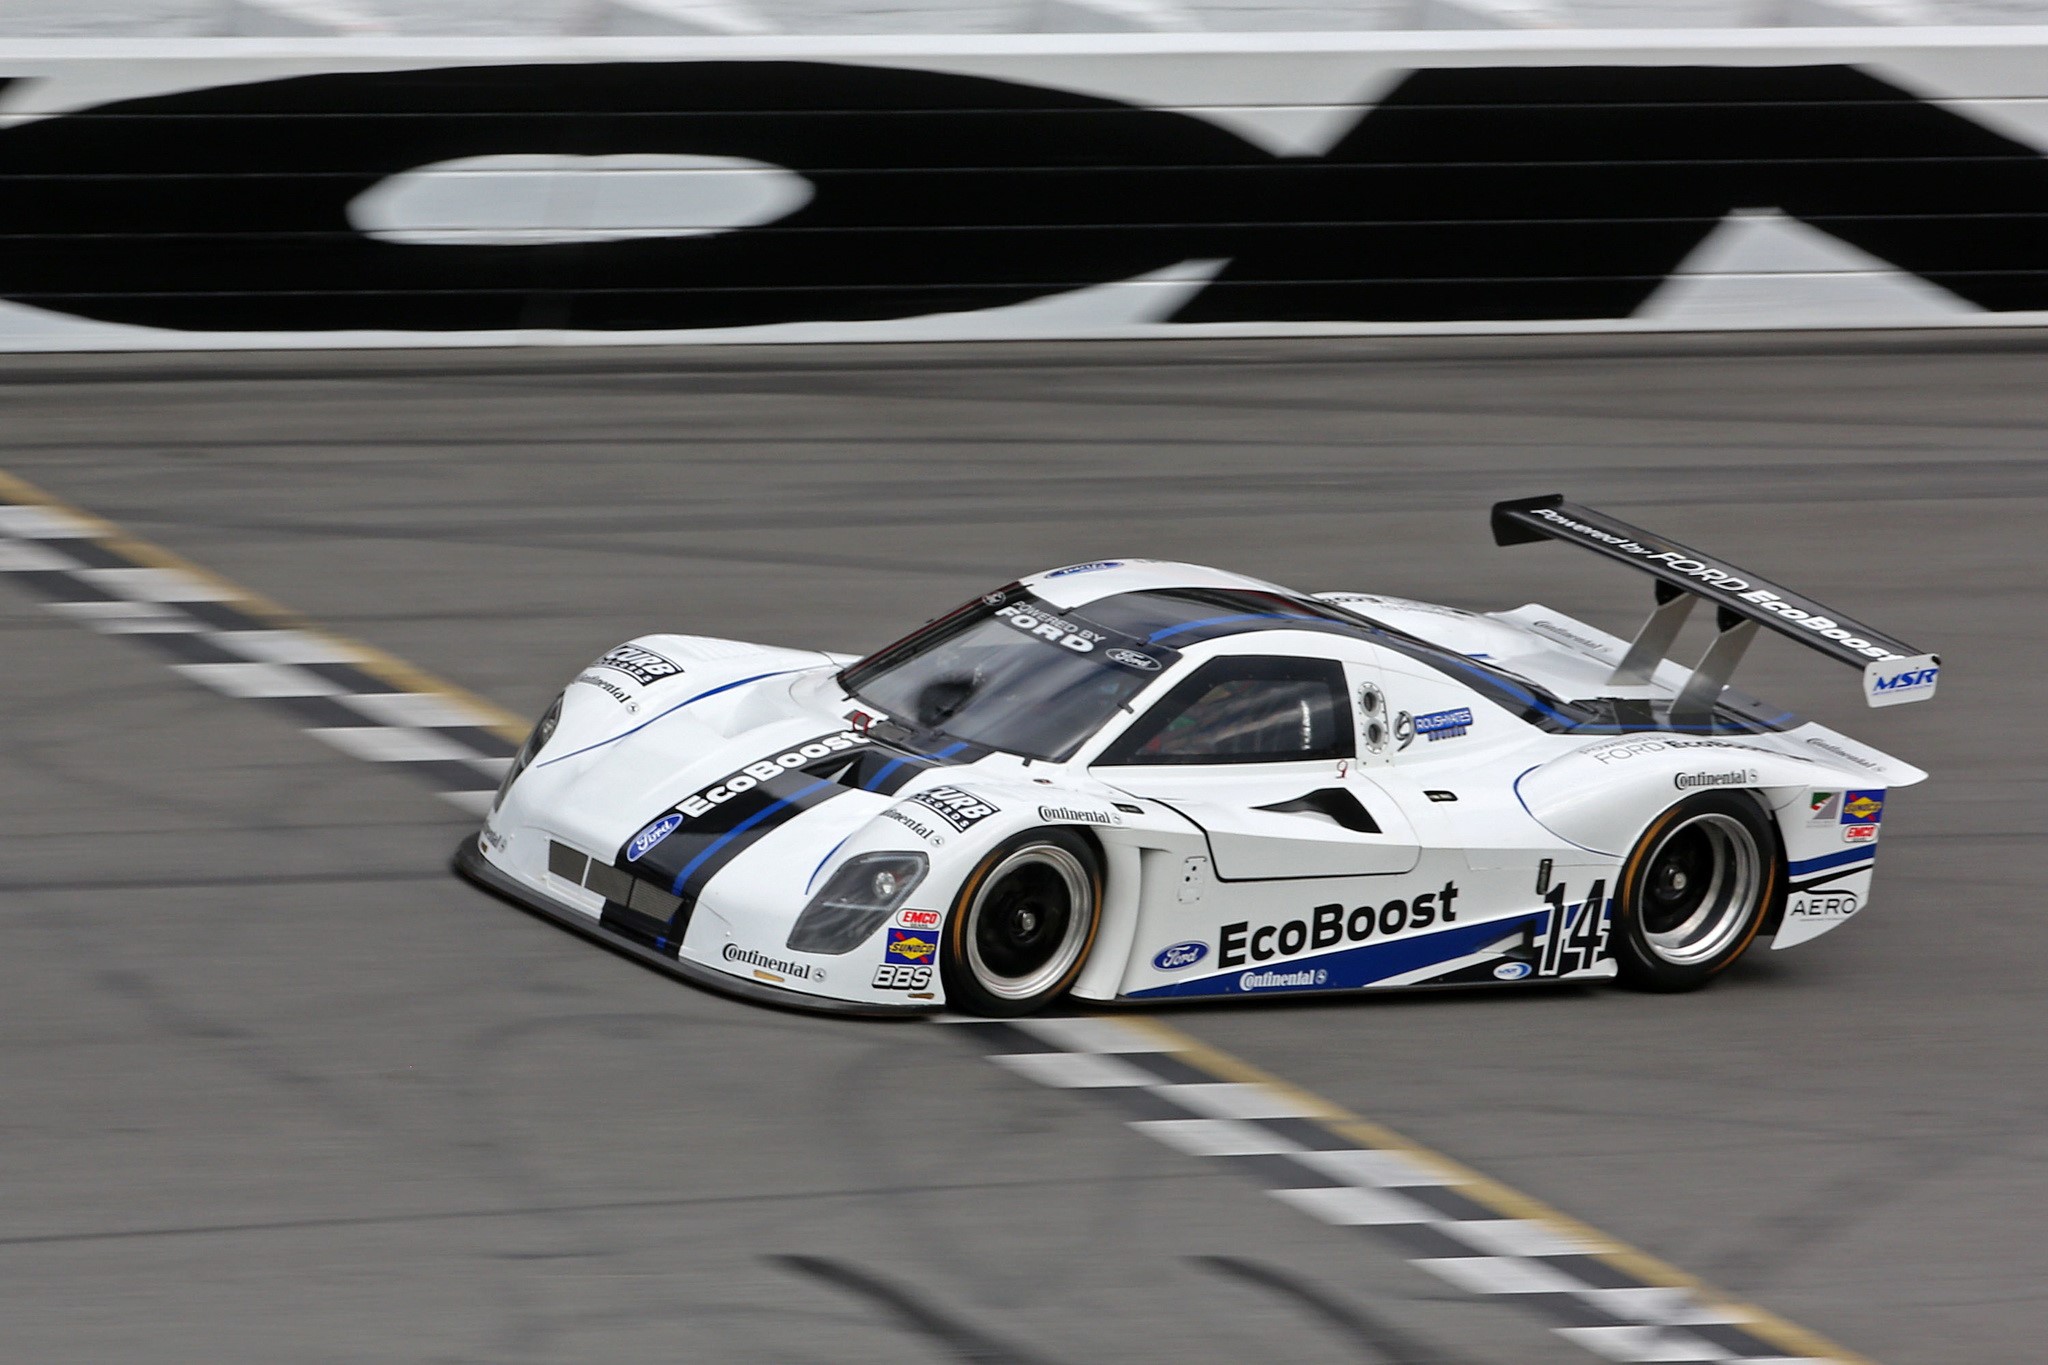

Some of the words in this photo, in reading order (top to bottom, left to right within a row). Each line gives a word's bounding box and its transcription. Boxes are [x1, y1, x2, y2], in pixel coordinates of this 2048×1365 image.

[1530, 508, 1629, 544] Powered
[1619, 541, 1652, 554] by
[1647, 551, 1749, 590] FORD
[995, 606, 1094, 653] FORD
[1011, 600, 1078, 633] POWERED
[1079, 629, 1106, 643] BY
[1873, 668, 1940, 691] MSR
[676, 731, 871, 818] EcoBoost
[1673, 769, 1747, 791] Continental
[1037, 804, 1112, 825] Continental
[903, 911, 938, 924] EMCO
[1790, 897, 1858, 916] AERO
[1218, 881, 1458, 969] EcoBoost
[1541, 879, 1606, 973] 14
[722, 942, 812, 979] Continental
[891, 943, 935, 953] SUNOCO
[871, 964, 933, 990] BBS
[1239, 969, 1315, 991] Continental
